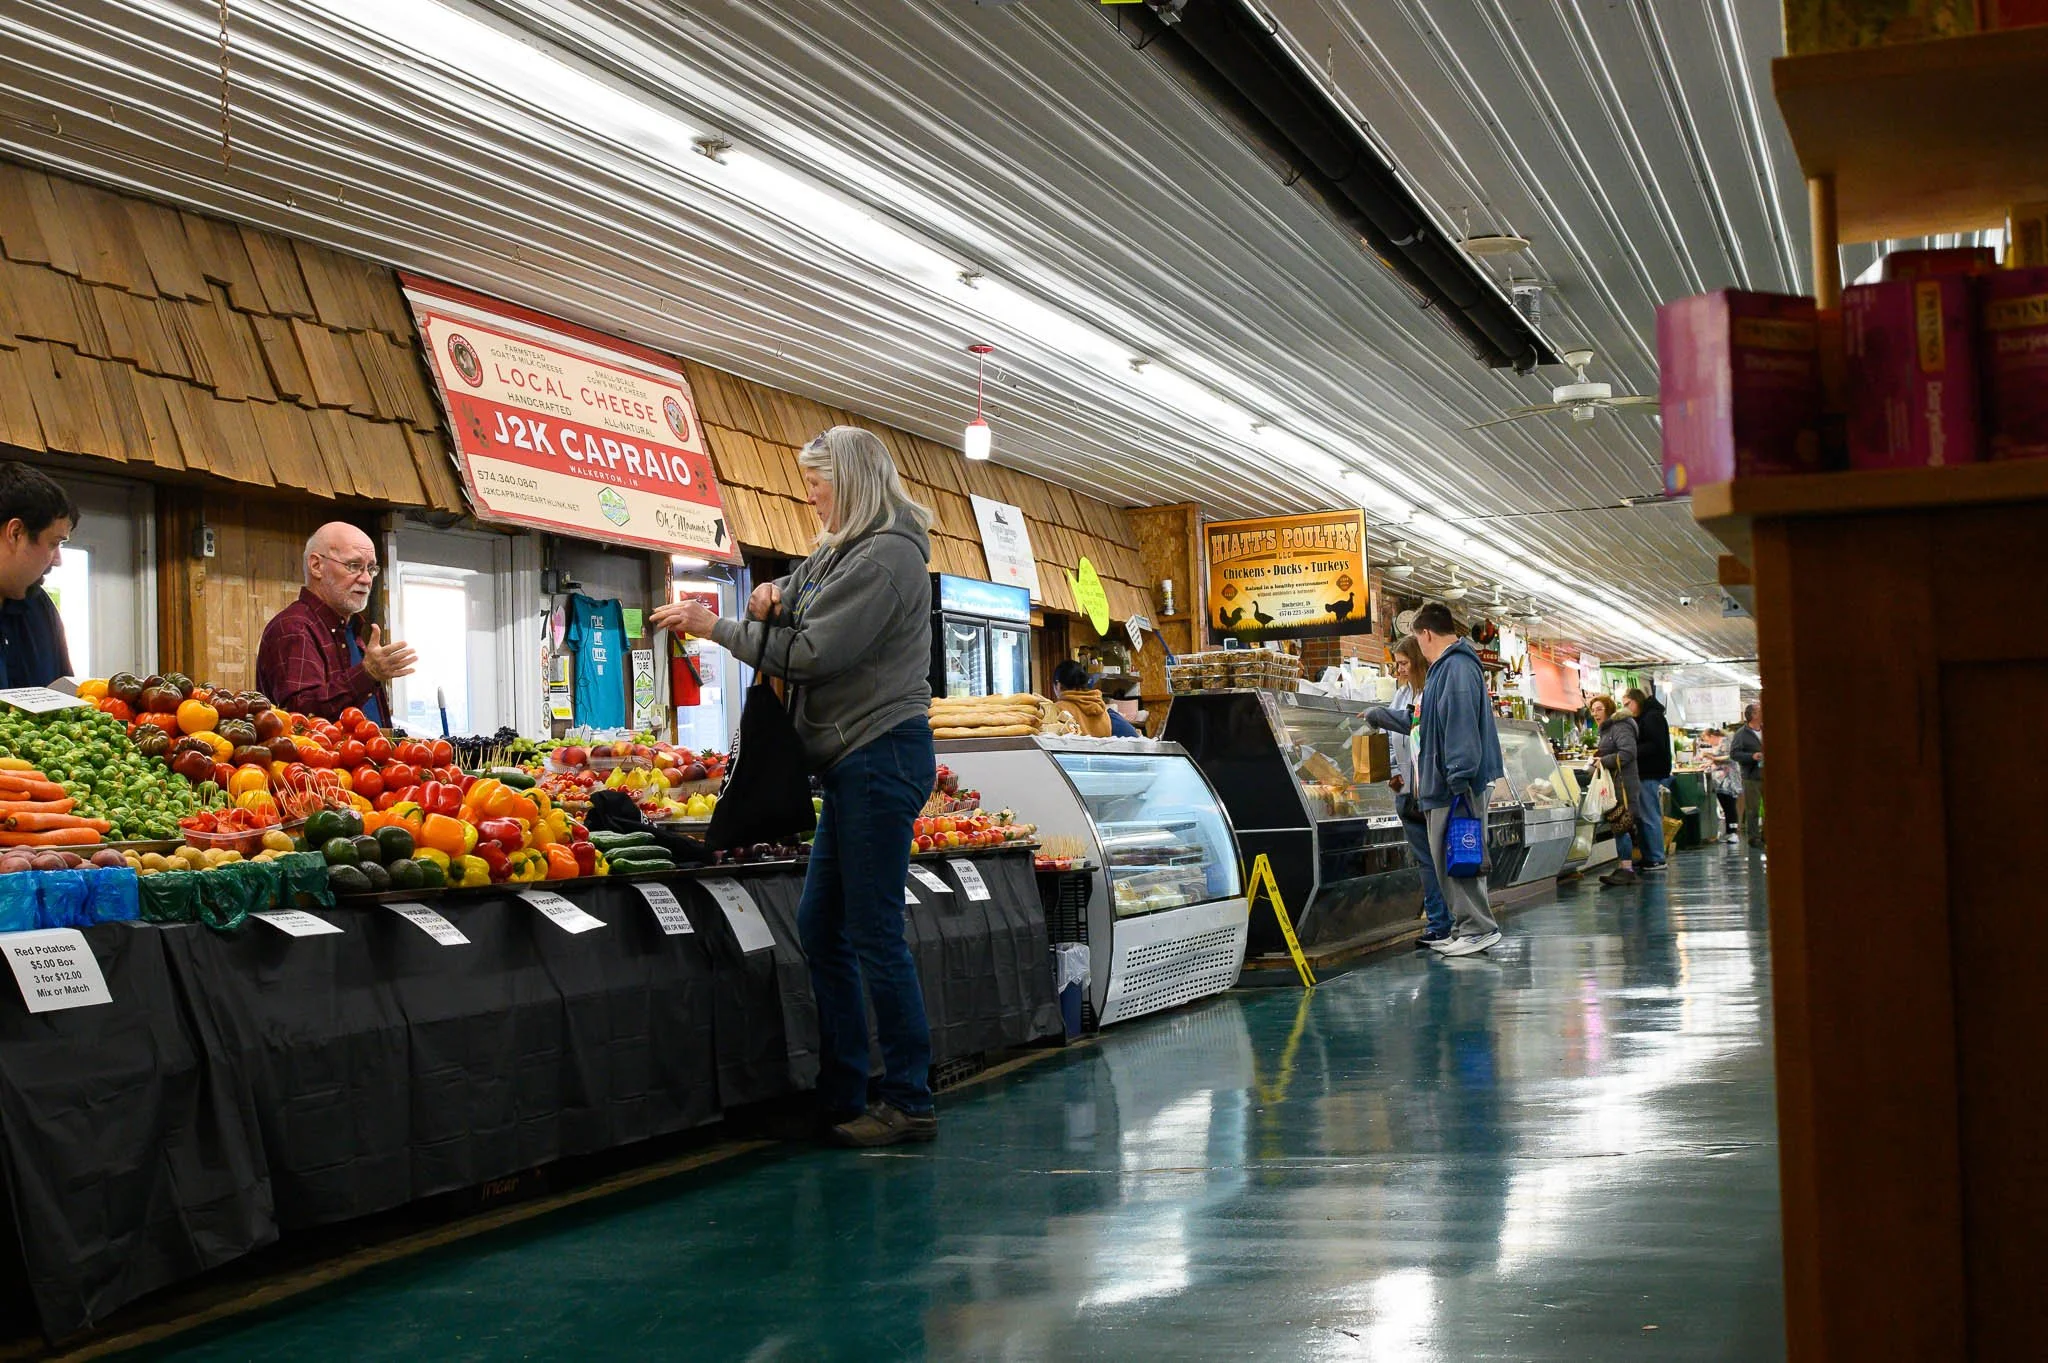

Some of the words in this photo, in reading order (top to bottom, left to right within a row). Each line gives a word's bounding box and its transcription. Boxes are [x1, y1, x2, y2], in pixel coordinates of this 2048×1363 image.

[504, 344, 546, 361] FARMSTEAD
[519, 356, 535, 368] MILK
[536, 361, 564, 375] CHEESE
[494, 363, 573, 400] LOCAL
[580, 387, 658, 424] CHEESE
[507, 392, 572, 416] HANDCRAFTED
[604, 416, 656, 437] ALL-NATURAL
[494, 411, 557, 456] J2K
[559, 428, 692, 486] CAPRAIO
[477, 470, 538, 490] 574.340.0847
[629, 479, 639, 487] IN
[1211, 528, 1277, 565] HIATT'S
[1282, 522, 1358, 553] POULTRY
[1223, 567, 1265, 580] Chickens
[1273, 563, 1302, 575] Ducks
[1311, 560, 1349, 572] Turkeys
[1274, 582, 1294, 590] healthy
[634, 651, 650, 661] PROUD
[642, 662, 649, 670] BE
[14, 947, 34, 957] Red
[35, 944, 77, 955] Potatoes
[30, 958, 56, 970] $5.00
[56, 958, 75, 967] Box
[34, 975, 40, 983] 3
[41, 974, 54, 983] for
[54, 970, 82, 982] $12.00
[36, 989, 53, 998] Mix
[54, 988, 63, 996] or
[64, 983, 90, 994] Match
